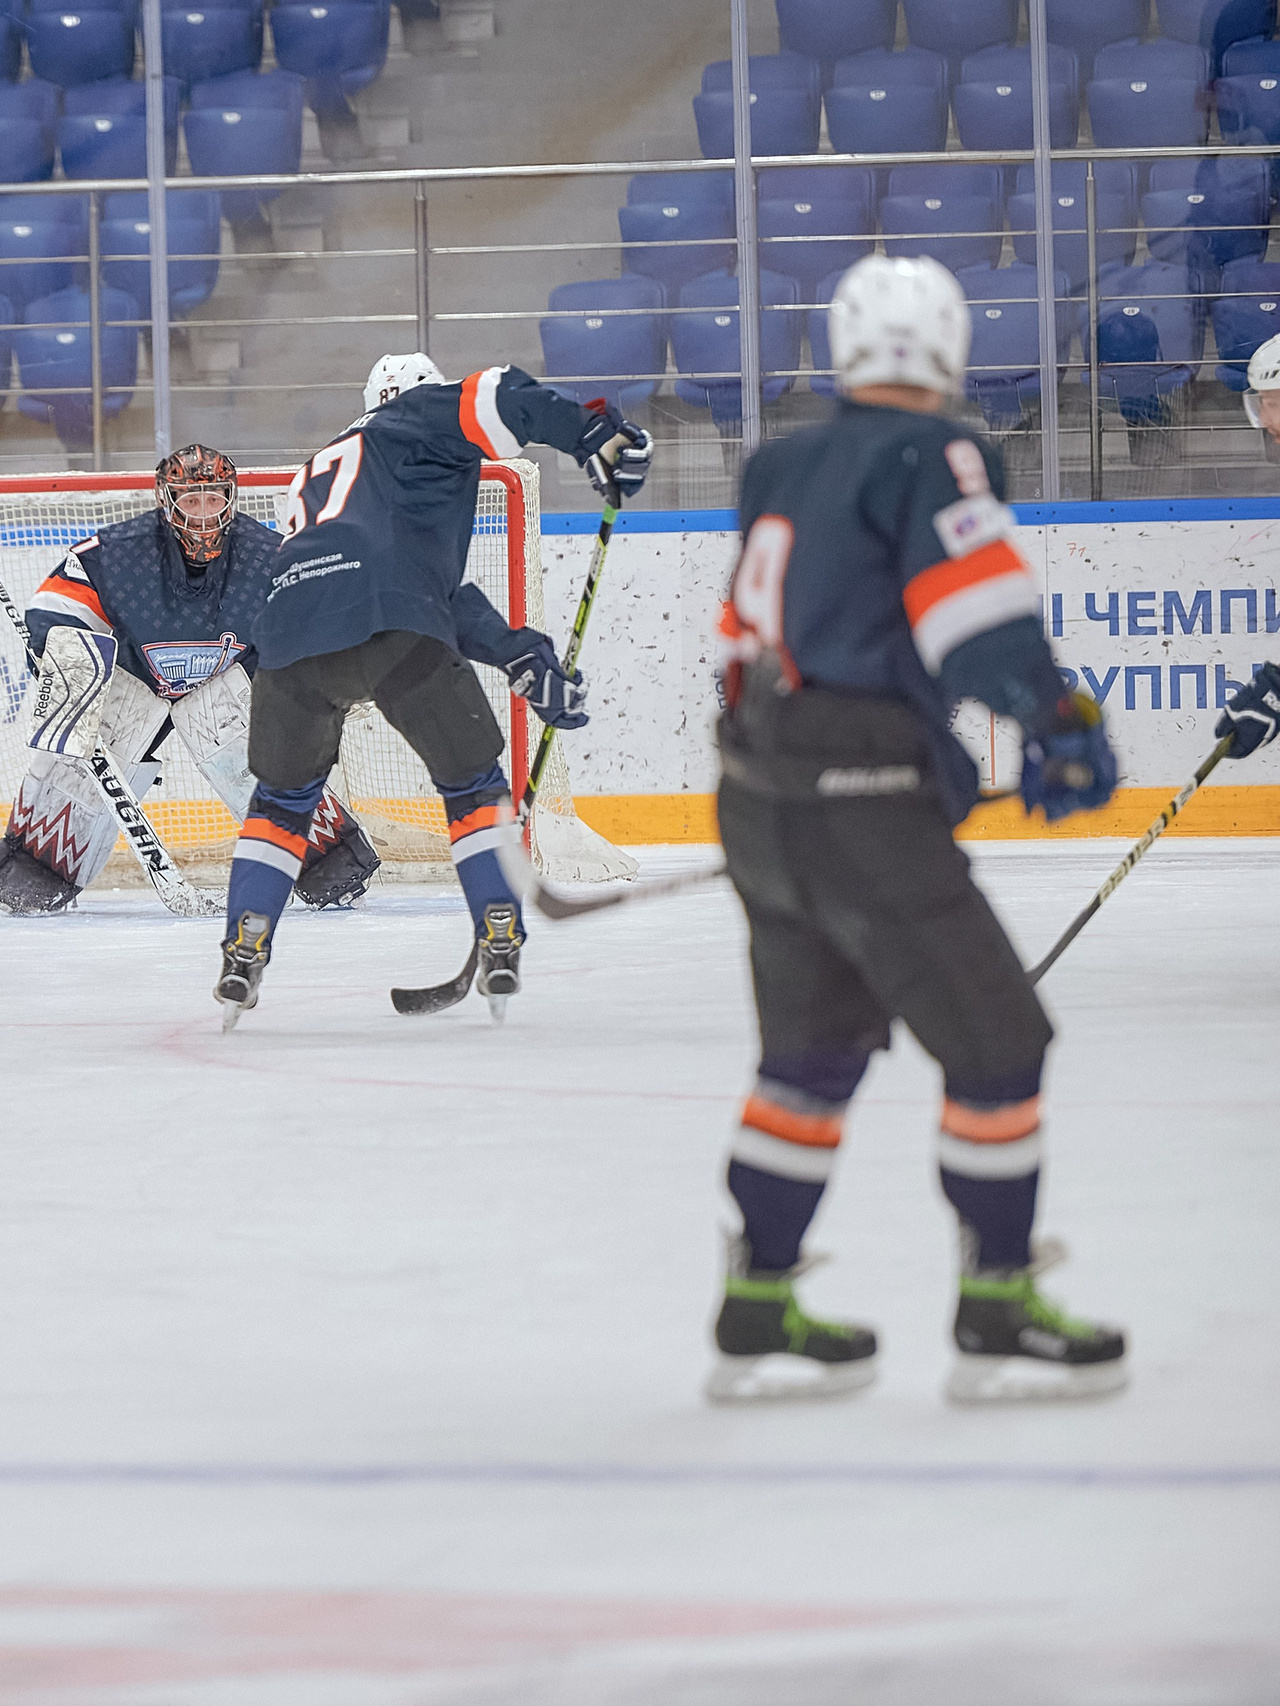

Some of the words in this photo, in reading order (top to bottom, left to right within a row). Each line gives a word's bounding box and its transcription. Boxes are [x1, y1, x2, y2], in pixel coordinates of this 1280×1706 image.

[379, 386, 400, 406] 87
[34, 670, 55, 718] Reebok
[91, 748, 170, 873] AUGHN
